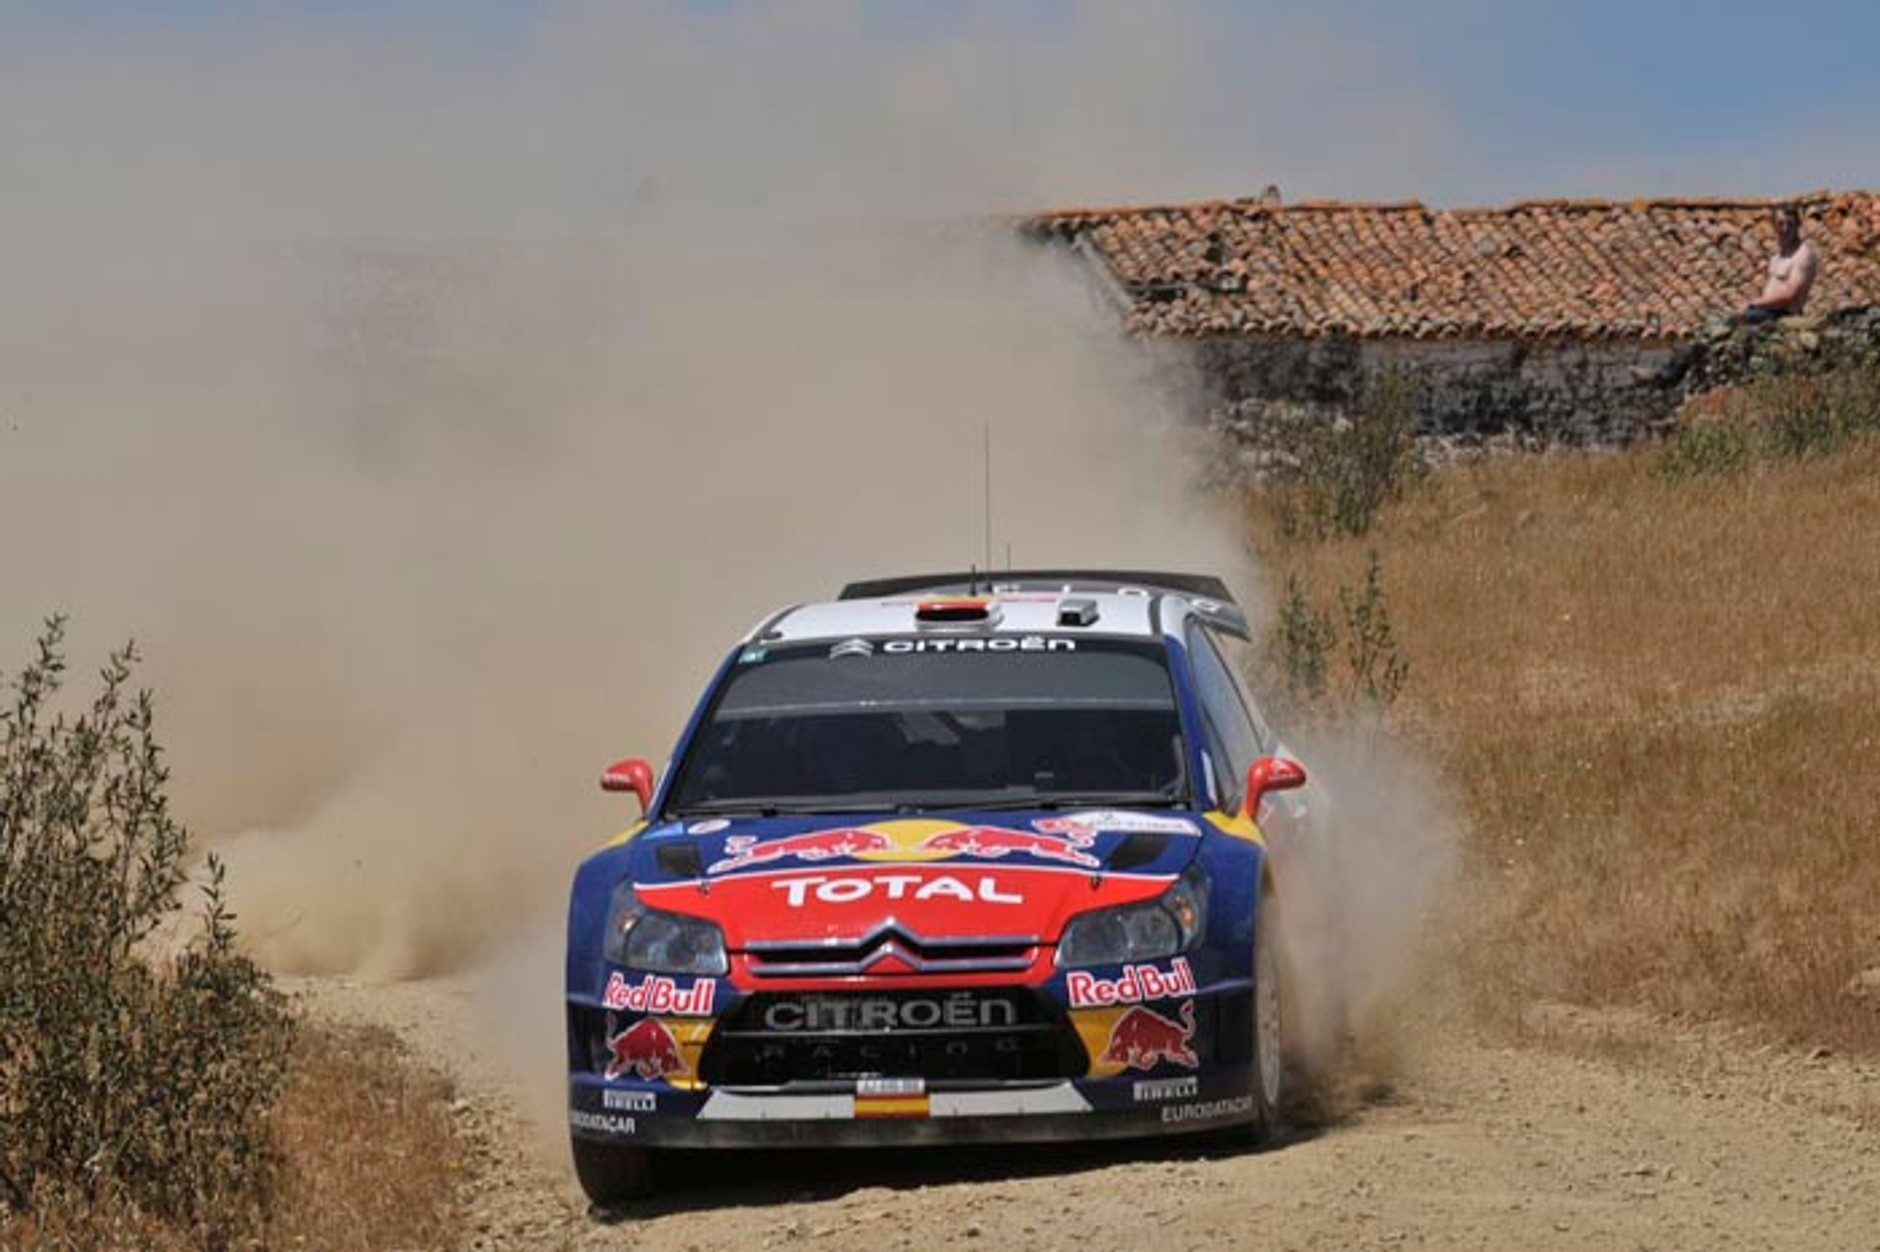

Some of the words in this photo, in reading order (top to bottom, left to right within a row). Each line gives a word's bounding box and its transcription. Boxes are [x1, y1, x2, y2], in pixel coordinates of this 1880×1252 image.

[771, 876, 1023, 907] TOTAL
[602, 970, 654, 1011] Red
[648, 976, 717, 1015] Bull
[1066, 964, 1141, 1009] Red
[1136, 956, 1197, 1000] Bull
